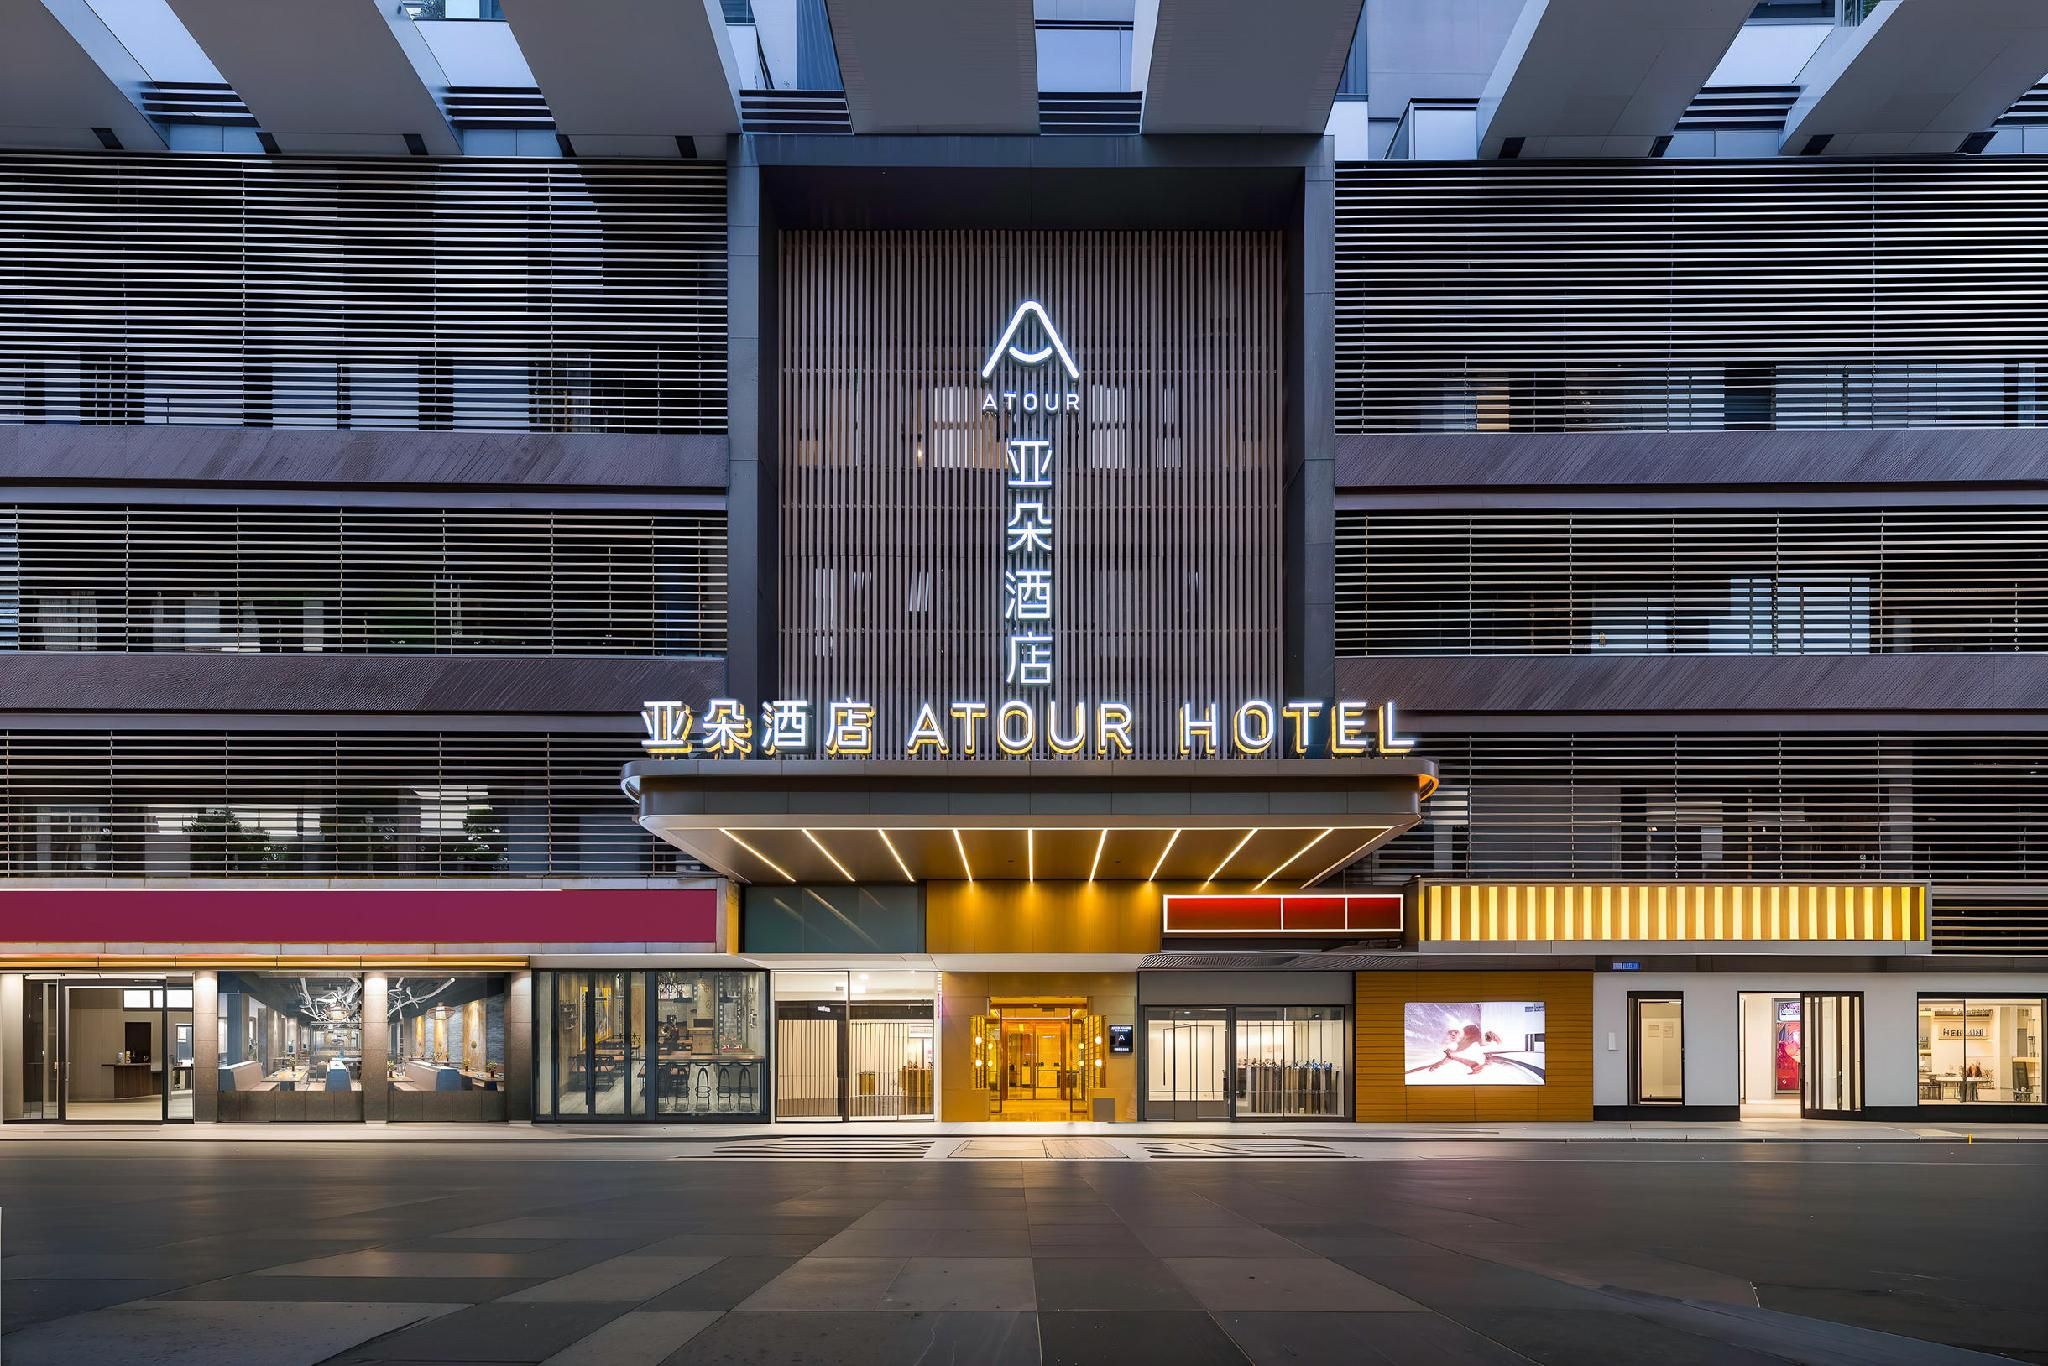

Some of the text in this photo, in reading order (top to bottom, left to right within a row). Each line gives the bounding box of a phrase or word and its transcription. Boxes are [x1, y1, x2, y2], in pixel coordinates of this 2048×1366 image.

[982, 393, 1080, 411] ATOUR
[1006, 440, 1053, 684] 亚朵酒店
[641, 697, 876, 754] 亚朵酒店
[907, 700, 1415, 755] ATOUR HOTEL
